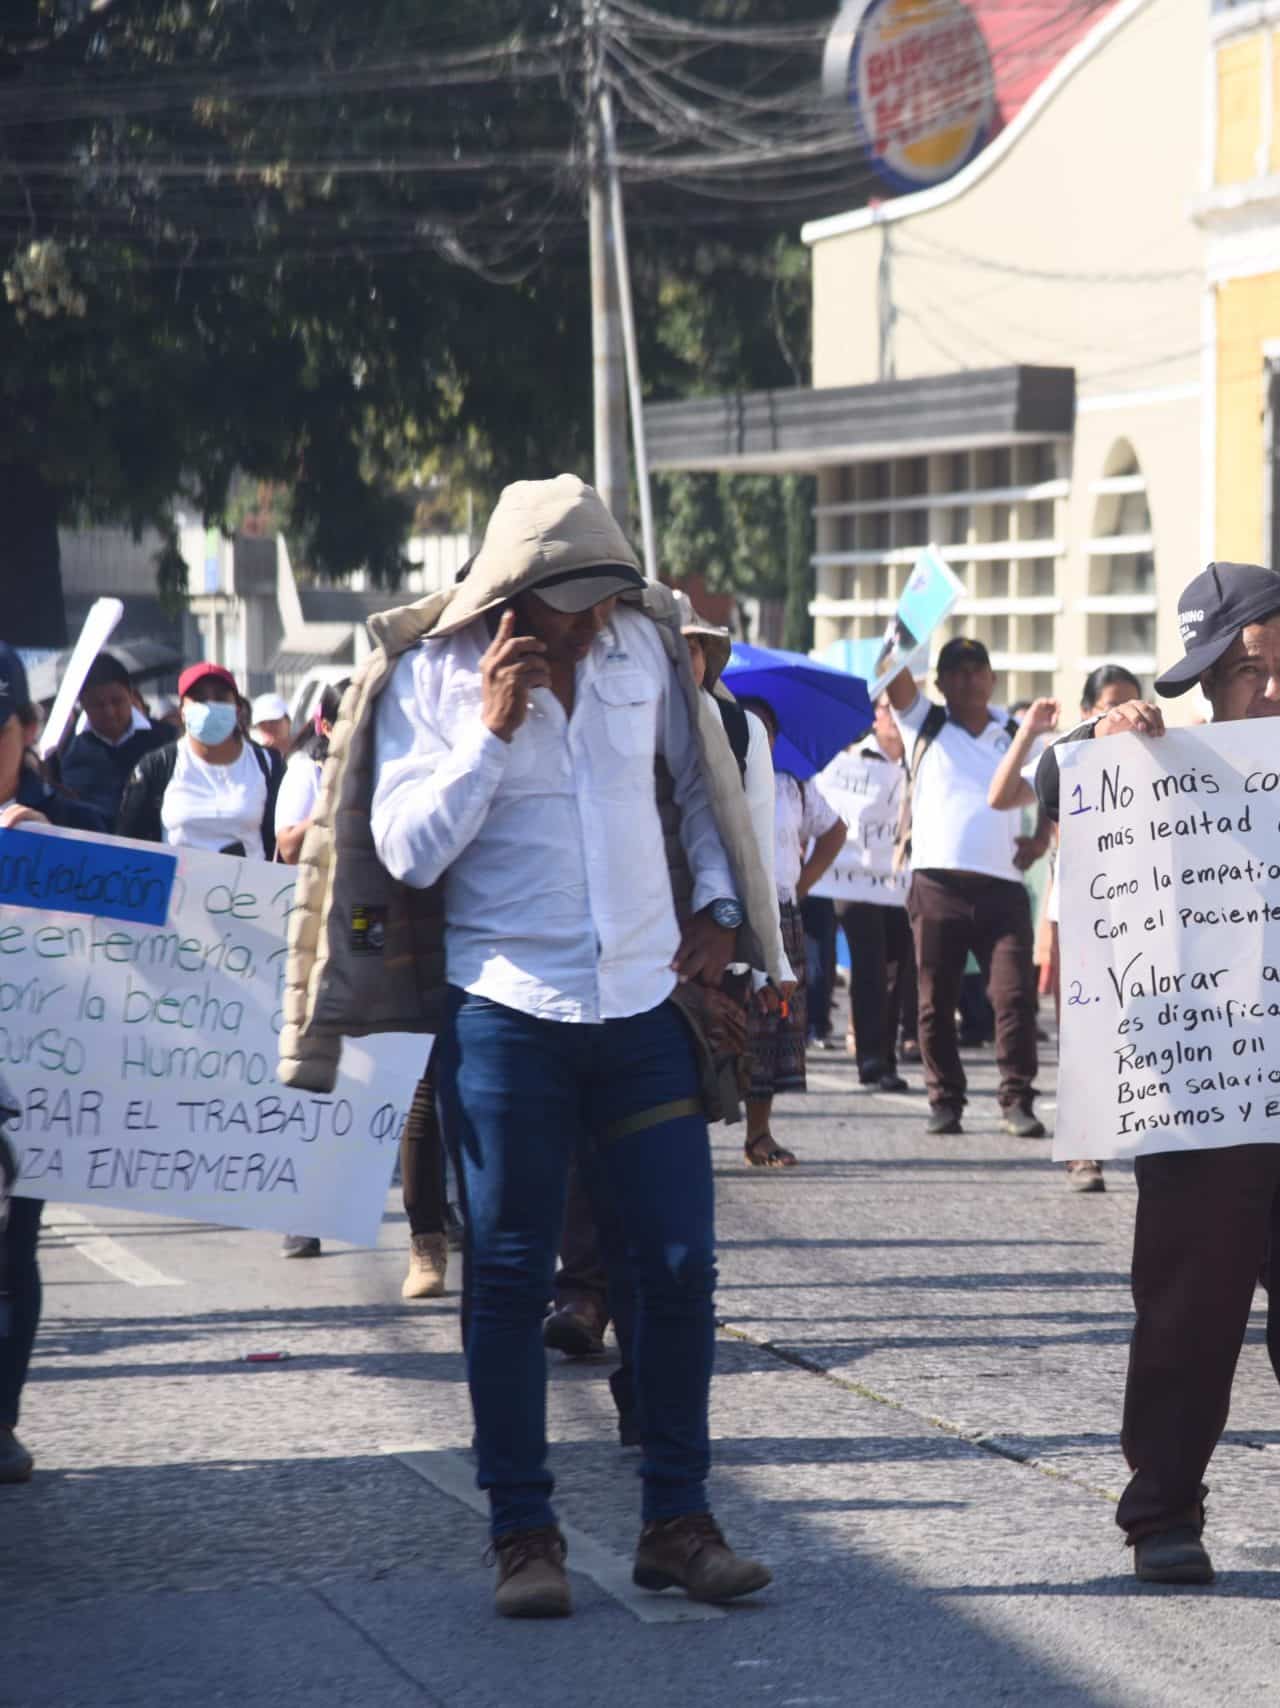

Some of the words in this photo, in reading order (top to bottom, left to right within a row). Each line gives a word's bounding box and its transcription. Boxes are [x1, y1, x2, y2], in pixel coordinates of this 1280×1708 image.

[1149, 804, 1253, 841] lealtad
[203, 861, 260, 920] de
[1152, 865, 1172, 892] la
[1143, 908, 1165, 932] el
[77, 974, 105, 1022] la
[1067, 979, 1100, 1006] 2.
[1107, 951, 1229, 1009] Valorar
[1262, 965, 1280, 983] a
[1117, 1081, 1171, 1105] Buen
[125, 1100, 160, 1130] EL
[175, 1094, 354, 1143] TRABAJO
[1116, 1105, 1225, 1136] Insumos
[87, 1146, 299, 1194] ENFERMERIA
